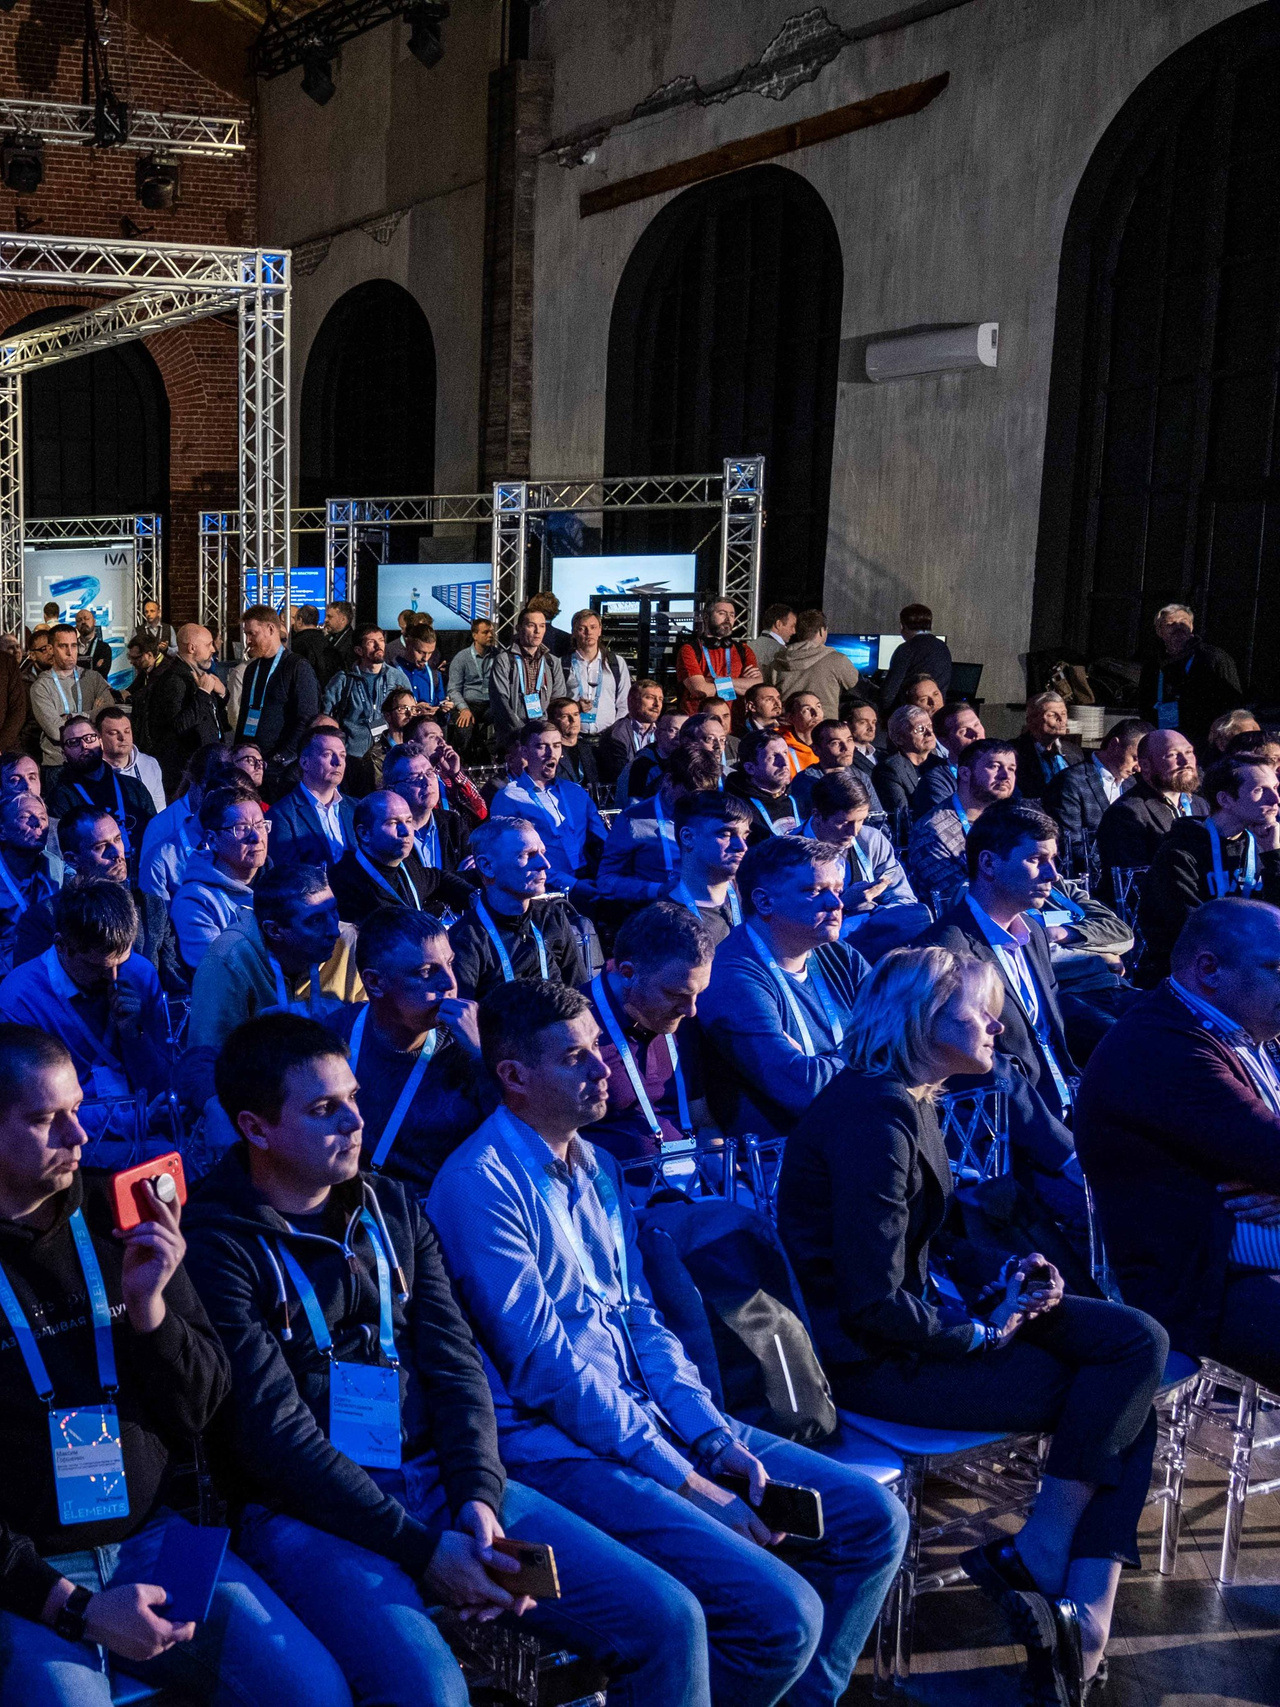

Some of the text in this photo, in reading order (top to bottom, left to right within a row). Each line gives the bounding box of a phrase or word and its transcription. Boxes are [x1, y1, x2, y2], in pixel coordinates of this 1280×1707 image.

[105, 553, 127, 566] IVA
[75, 1228, 107, 1314] IT ELEMENTS
[64, 1501, 73, 1510] IT
[64, 1503, 127, 1520] ELEMENTS
